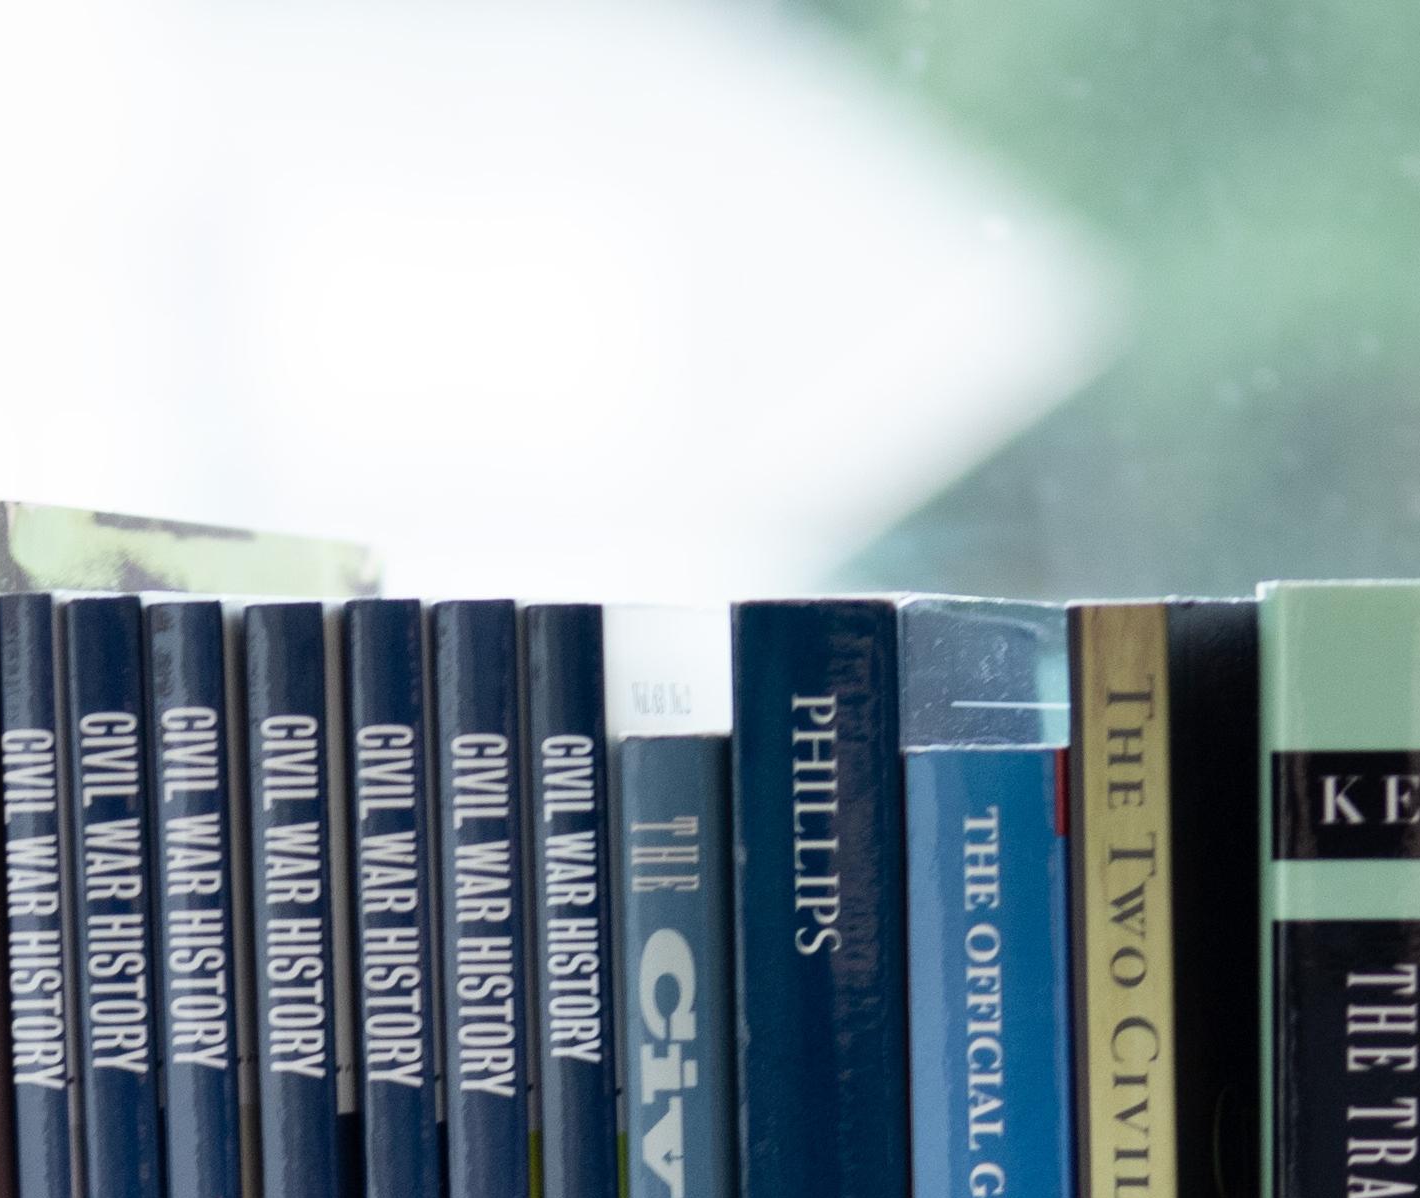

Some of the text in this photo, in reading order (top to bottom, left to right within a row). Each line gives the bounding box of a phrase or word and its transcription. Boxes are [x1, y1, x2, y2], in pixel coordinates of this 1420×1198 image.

[630, 815, 699, 893] THE
[791, 693, 842, 957] PHILLIPS
[1106, 675, 1154, 808] THE
[1, 728, 67, 1091] CIVIL WAR HISTORY
[80, 711, 149, 1074] CIVIL WAR HISTORY
[160, 706, 229, 1070] CIVIL WAR HISTORY
[541, 733, 603, 1063] CIVIL WAR HISTORY
[964, 807, 999, 910] THE
[1108, 831, 1156, 988] TWO
[964, 923, 1004, 1151] OFFICIAL
[1346, 963, 1418, 1073] THE
